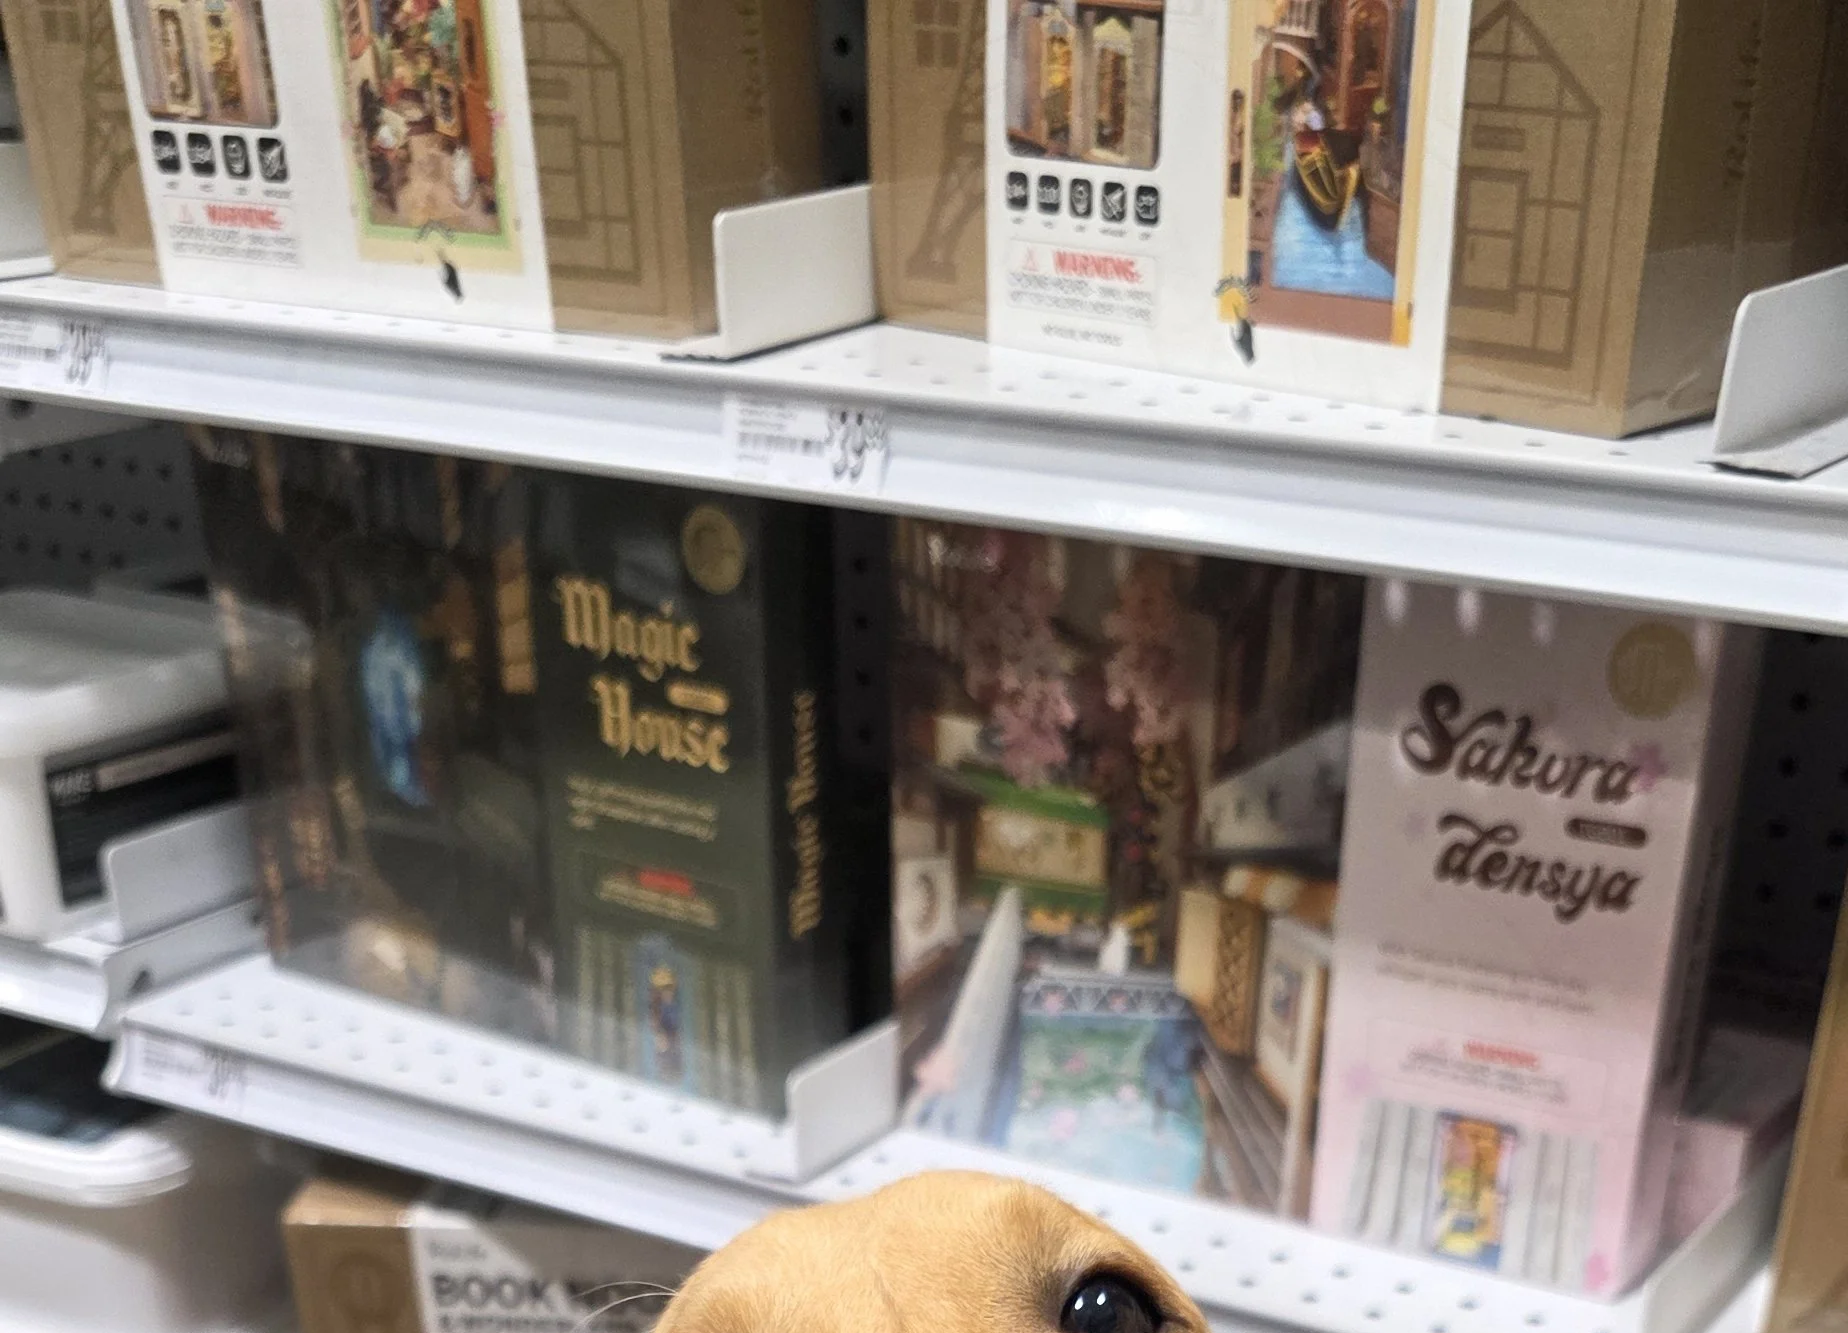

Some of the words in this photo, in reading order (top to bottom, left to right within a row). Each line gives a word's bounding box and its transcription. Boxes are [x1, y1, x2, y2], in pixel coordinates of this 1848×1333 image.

[556, 574, 699, 680] Magic
[590, 676, 730, 773] House
[1400, 683, 1640, 804] Sakura
[1433, 812, 1642, 925] densya
[432, 1271, 548, 1313] BOOK
